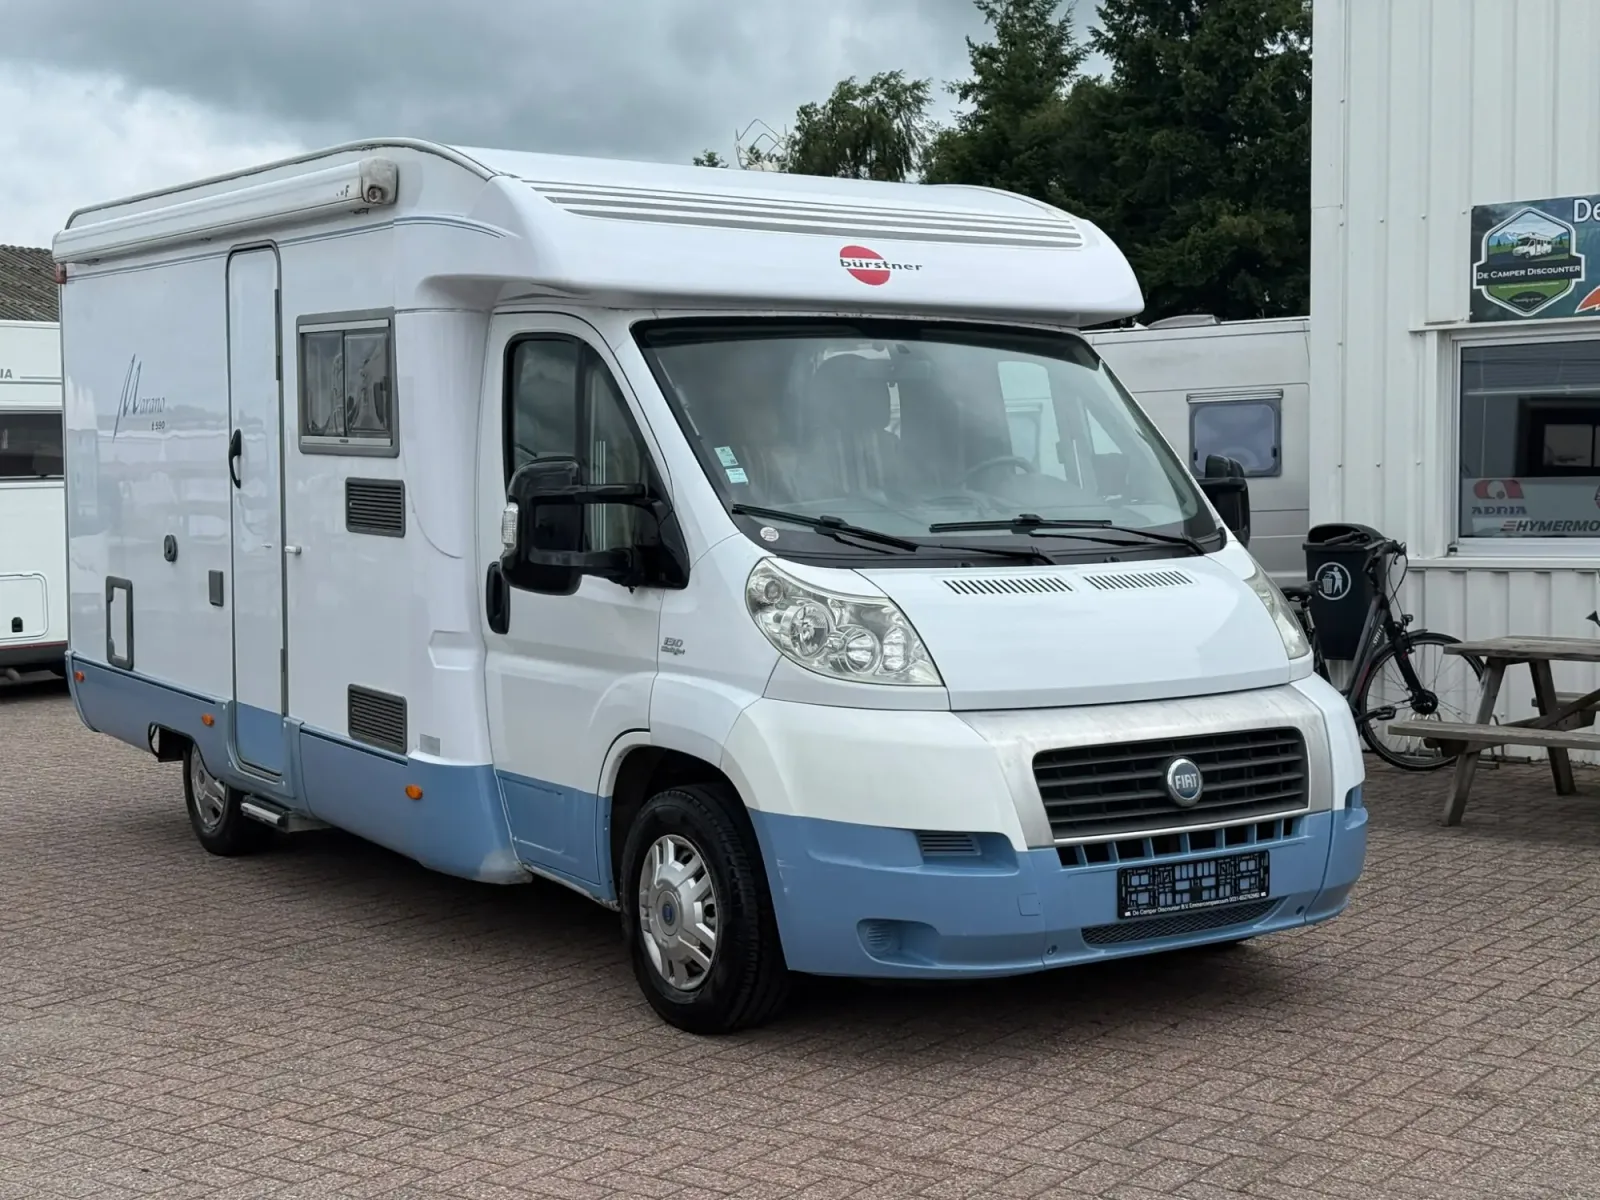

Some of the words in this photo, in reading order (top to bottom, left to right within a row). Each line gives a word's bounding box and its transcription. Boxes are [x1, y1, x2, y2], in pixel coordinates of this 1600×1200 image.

[840, 259, 923, 271] bürstner
[1471, 506, 1527, 515] ADRIA
[1516, 520, 1600, 532] HYMERMO
[1175, 773, 1197, 790] FIAT
